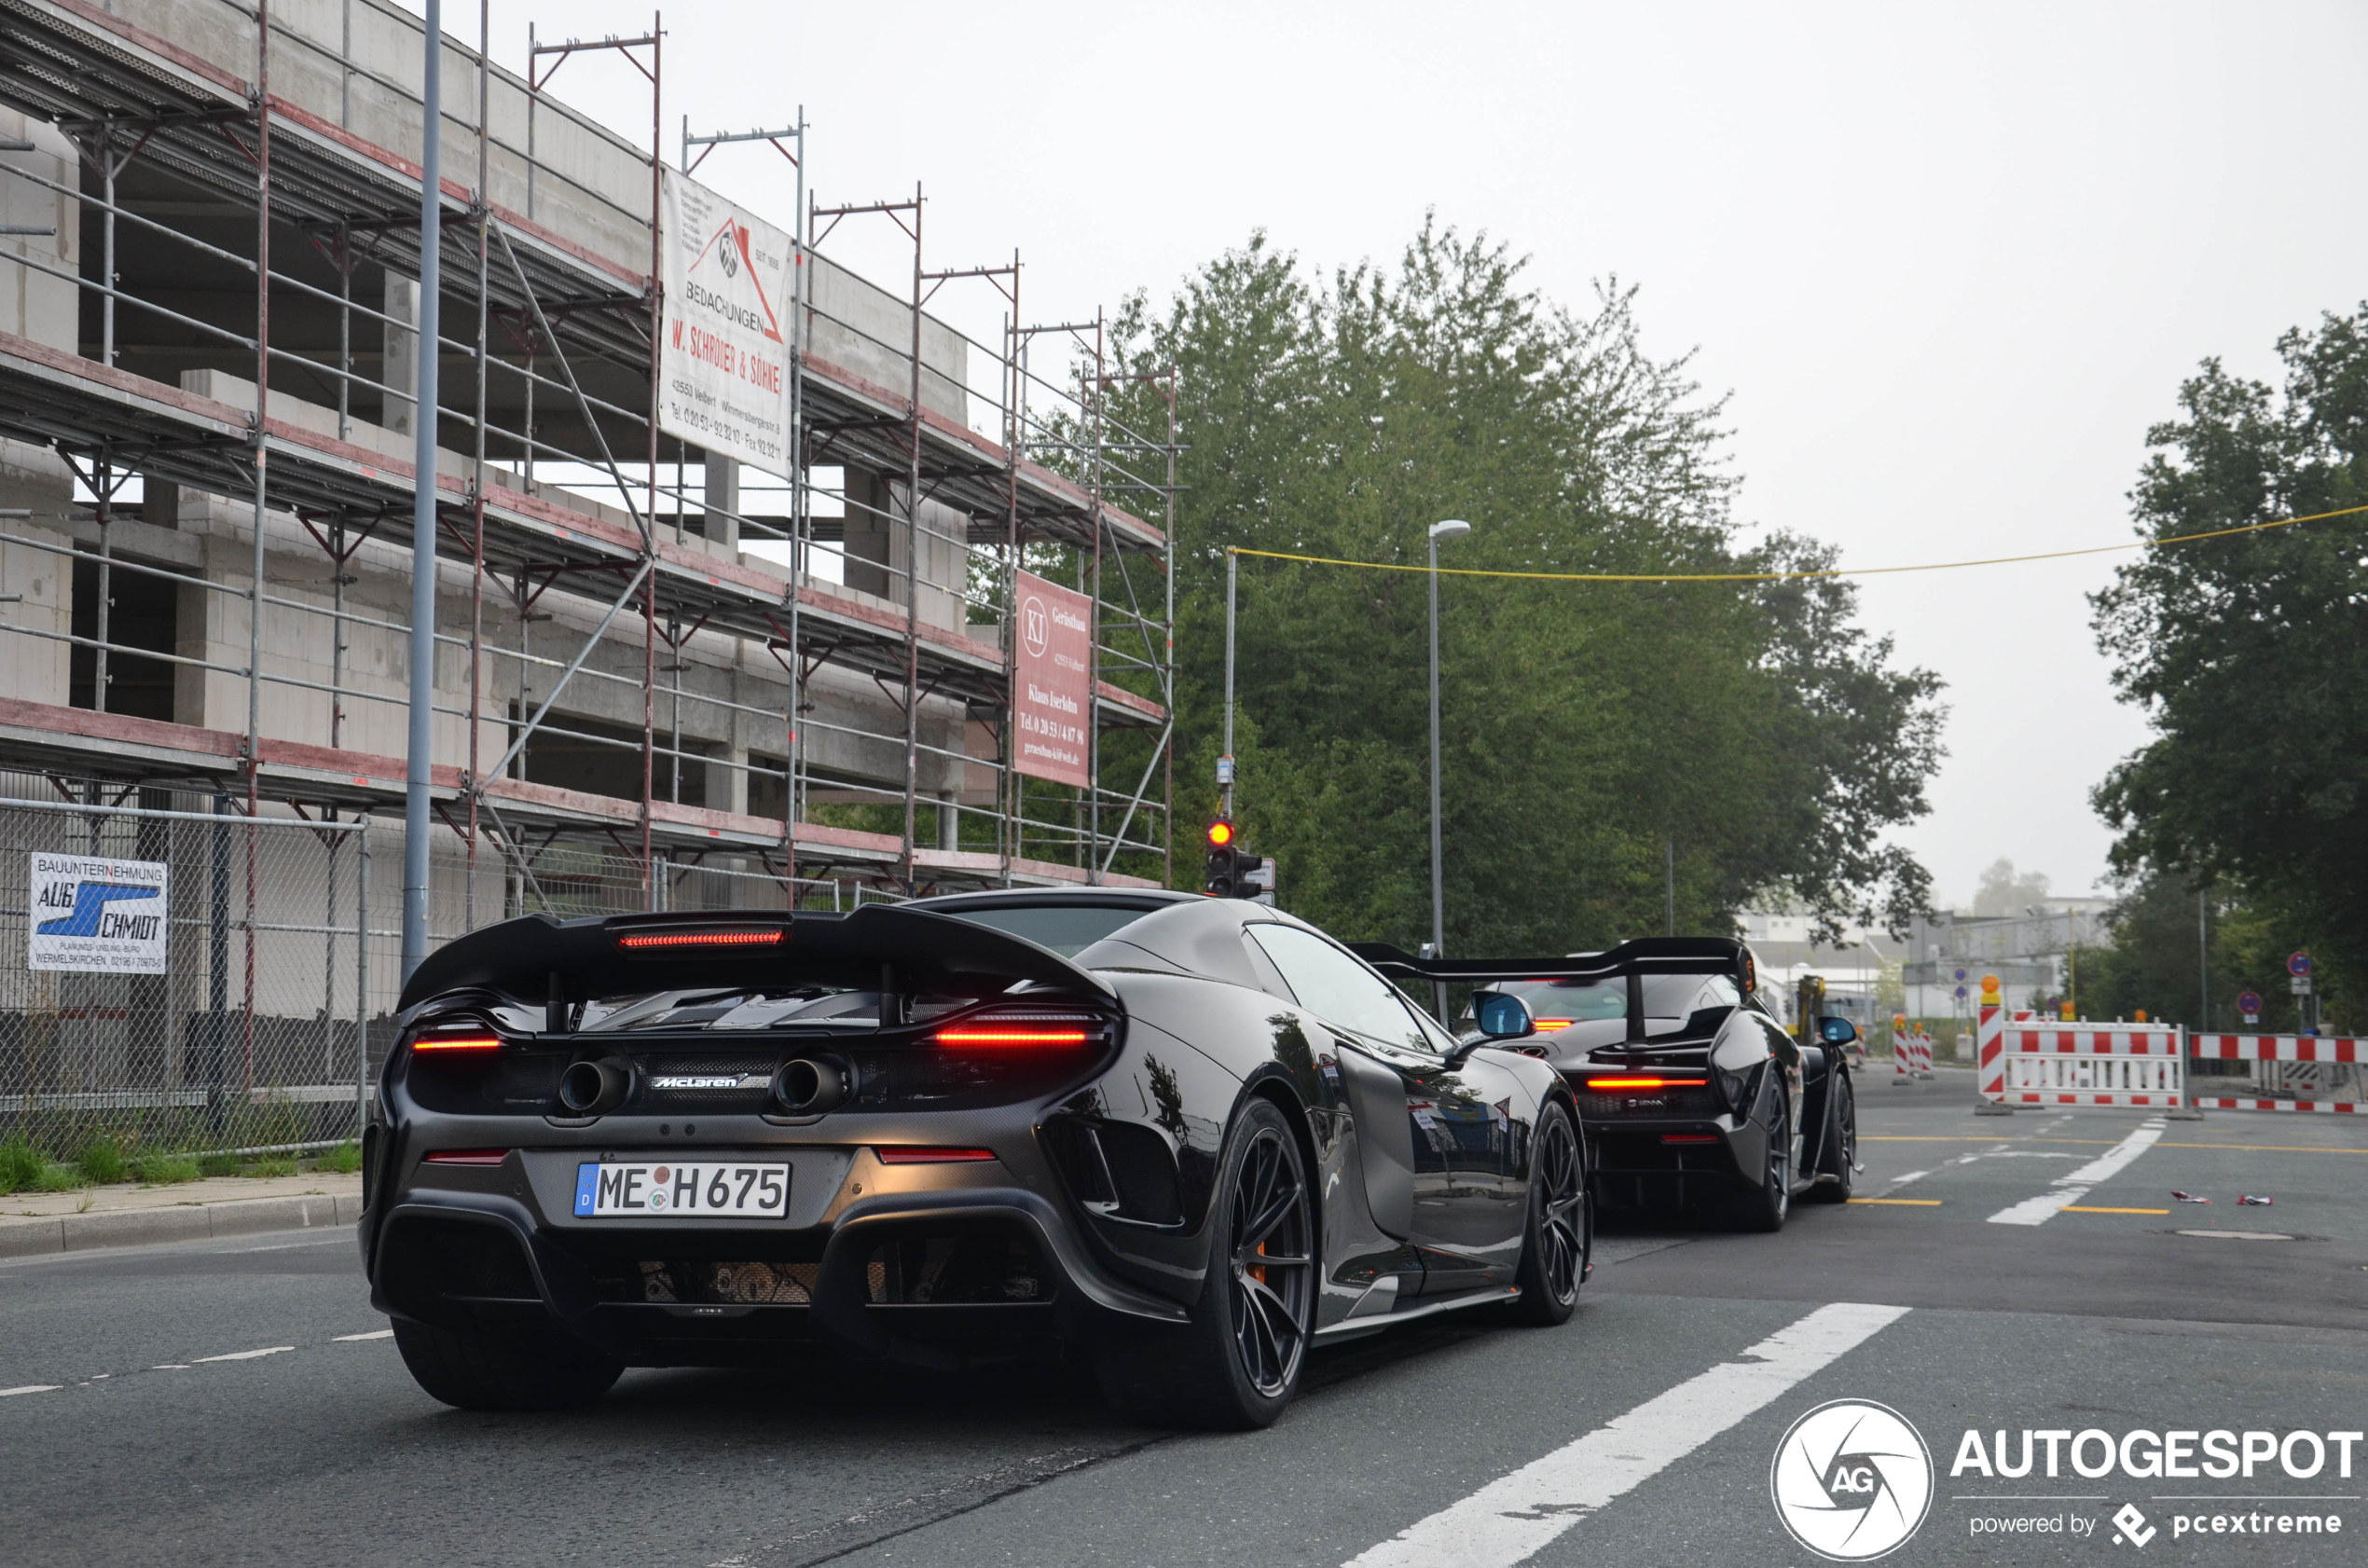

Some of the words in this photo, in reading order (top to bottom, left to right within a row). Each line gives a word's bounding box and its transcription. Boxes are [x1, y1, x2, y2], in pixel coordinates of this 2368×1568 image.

[755, 249, 766, 264] SEIT
[686, 281, 764, 334] BEDACHUNGEN
[672, 318, 685, 351] W.
[690, 326, 736, 376] SCHRÖDER
[739, 351, 746, 380] &
[750, 351, 779, 394] SÖHNE
[671, 378, 693, 397] 42553
[695, 387, 716, 407] Velbert
[671, 402, 682, 421] Tel.
[745, 433, 756, 451] Fax
[1026, 609, 1044, 645] KI
[1052, 607, 1086, 632] Gerüstbau
[1028, 683, 1049, 706] Klaus
[1050, 691, 1078, 715] Iserlohn
[1020, 712, 1033, 732] Tel.
[38, 859, 162, 881] BAUUNTERNEHMUNG
[37, 881, 76, 908] AUG.
[35, 953, 106, 965] WERMELSKIRCHEN
[654, 1076, 739, 1088] McLaren
[581, 1194, 590, 1206] D
[598, 1168, 647, 1208] ME
[672, 1168, 699, 1208] H
[707, 1168, 784, 1209] 675
